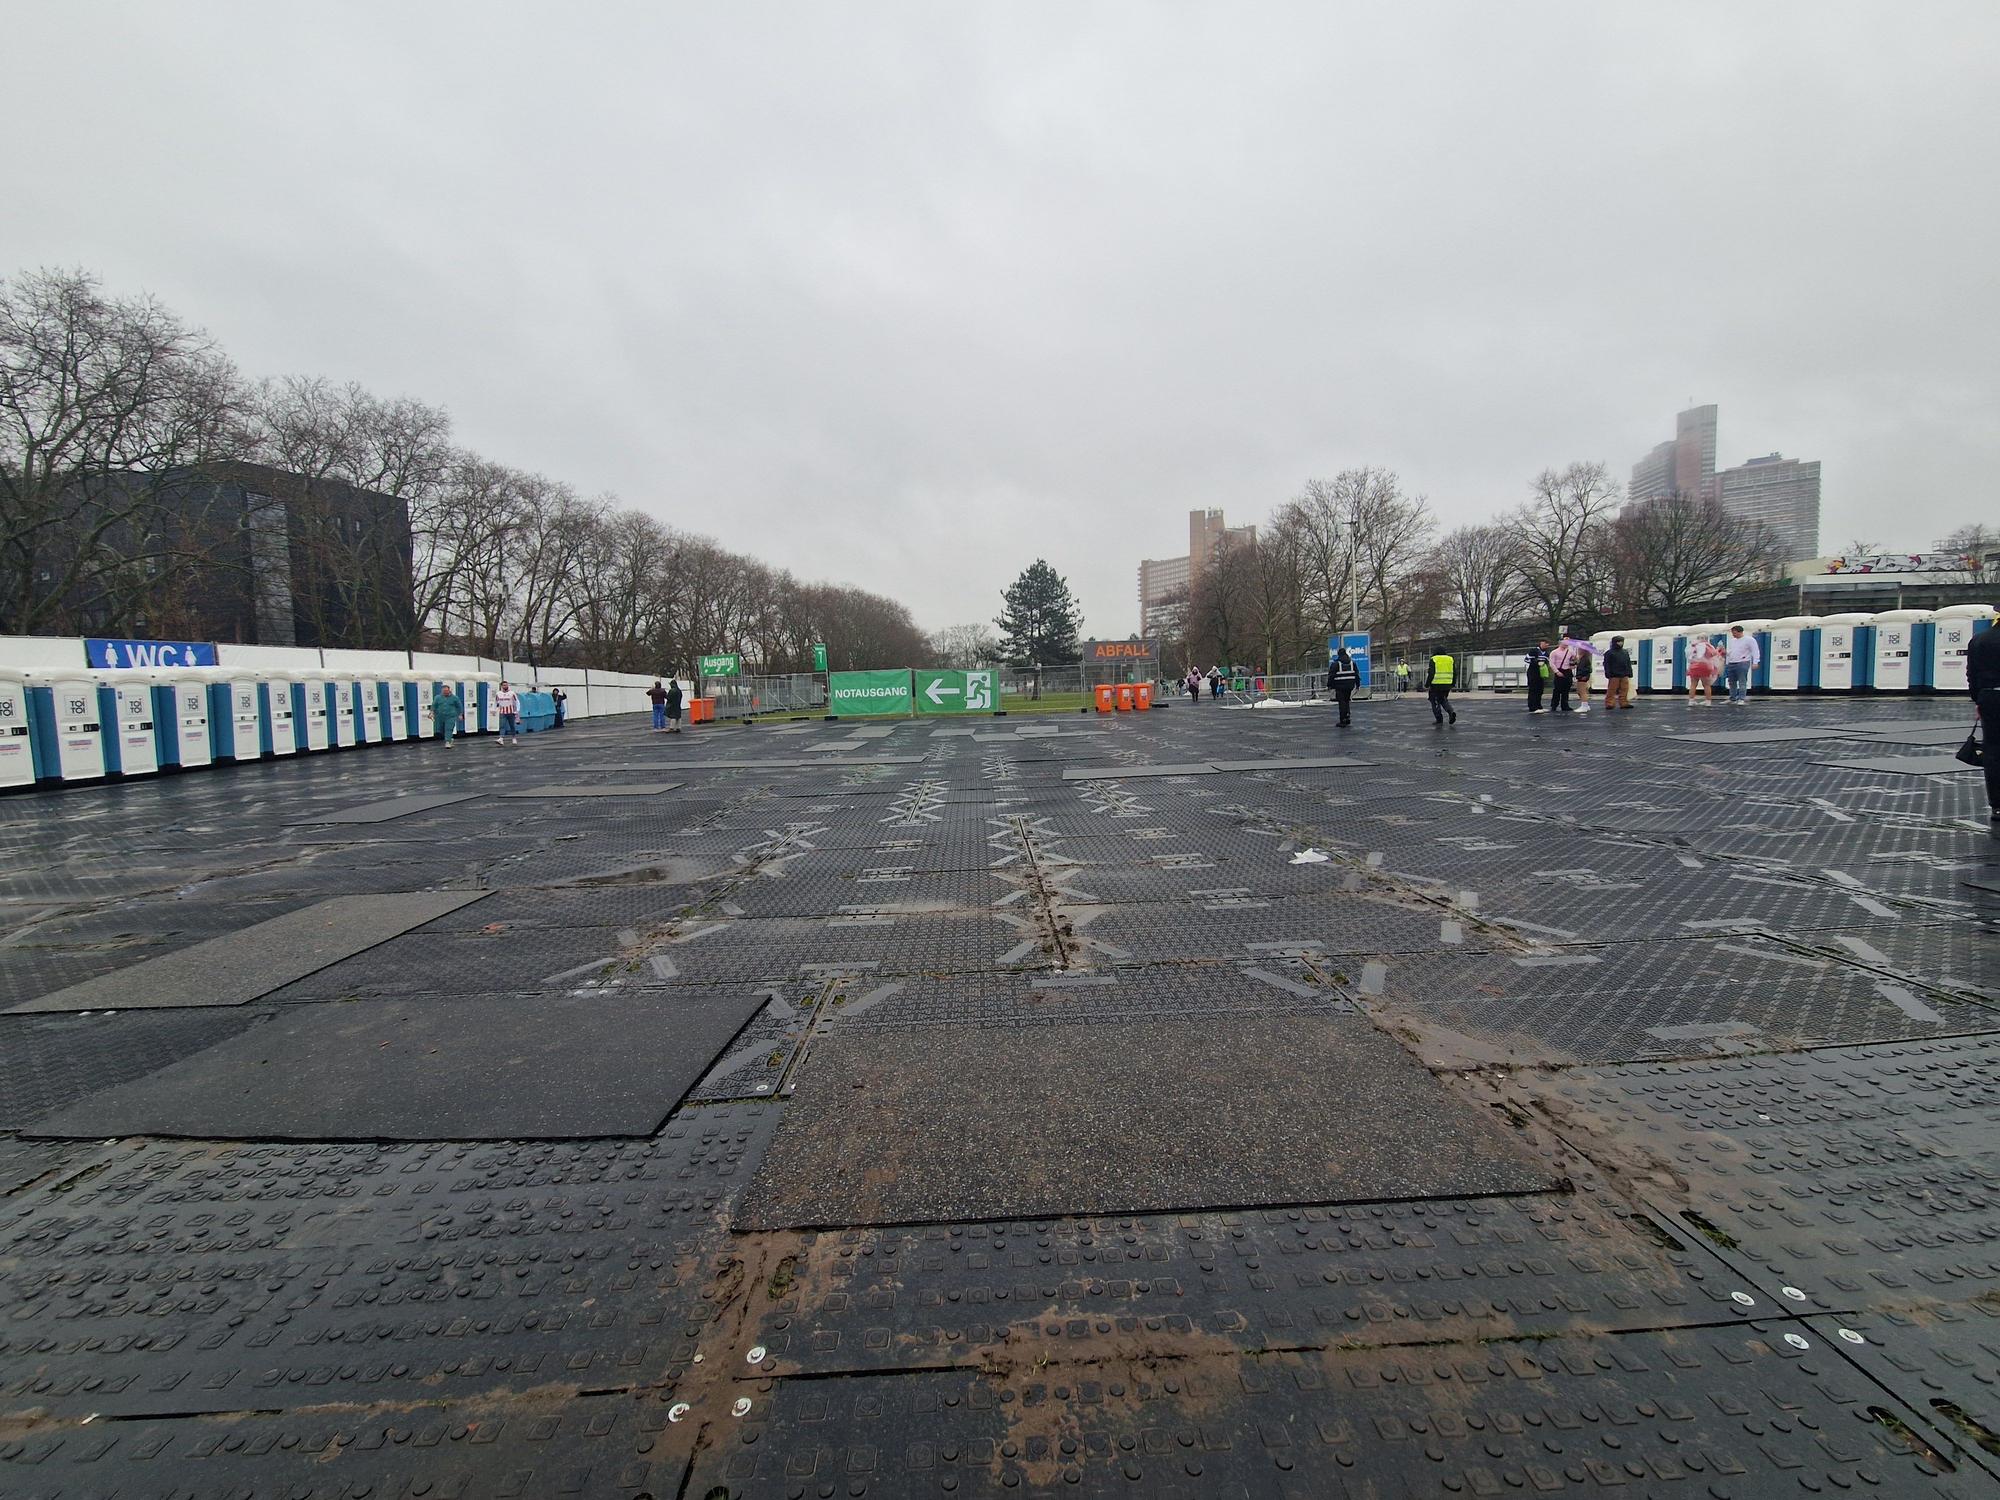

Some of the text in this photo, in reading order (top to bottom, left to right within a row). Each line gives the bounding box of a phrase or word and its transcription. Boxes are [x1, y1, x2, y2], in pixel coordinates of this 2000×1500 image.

[125, 645, 179, 667] WC
[1096, 644, 1150, 657] ABFALL
[703, 657, 735, 672] Ausgang
[835, 686, 908, 698] NOTAUSGANG
